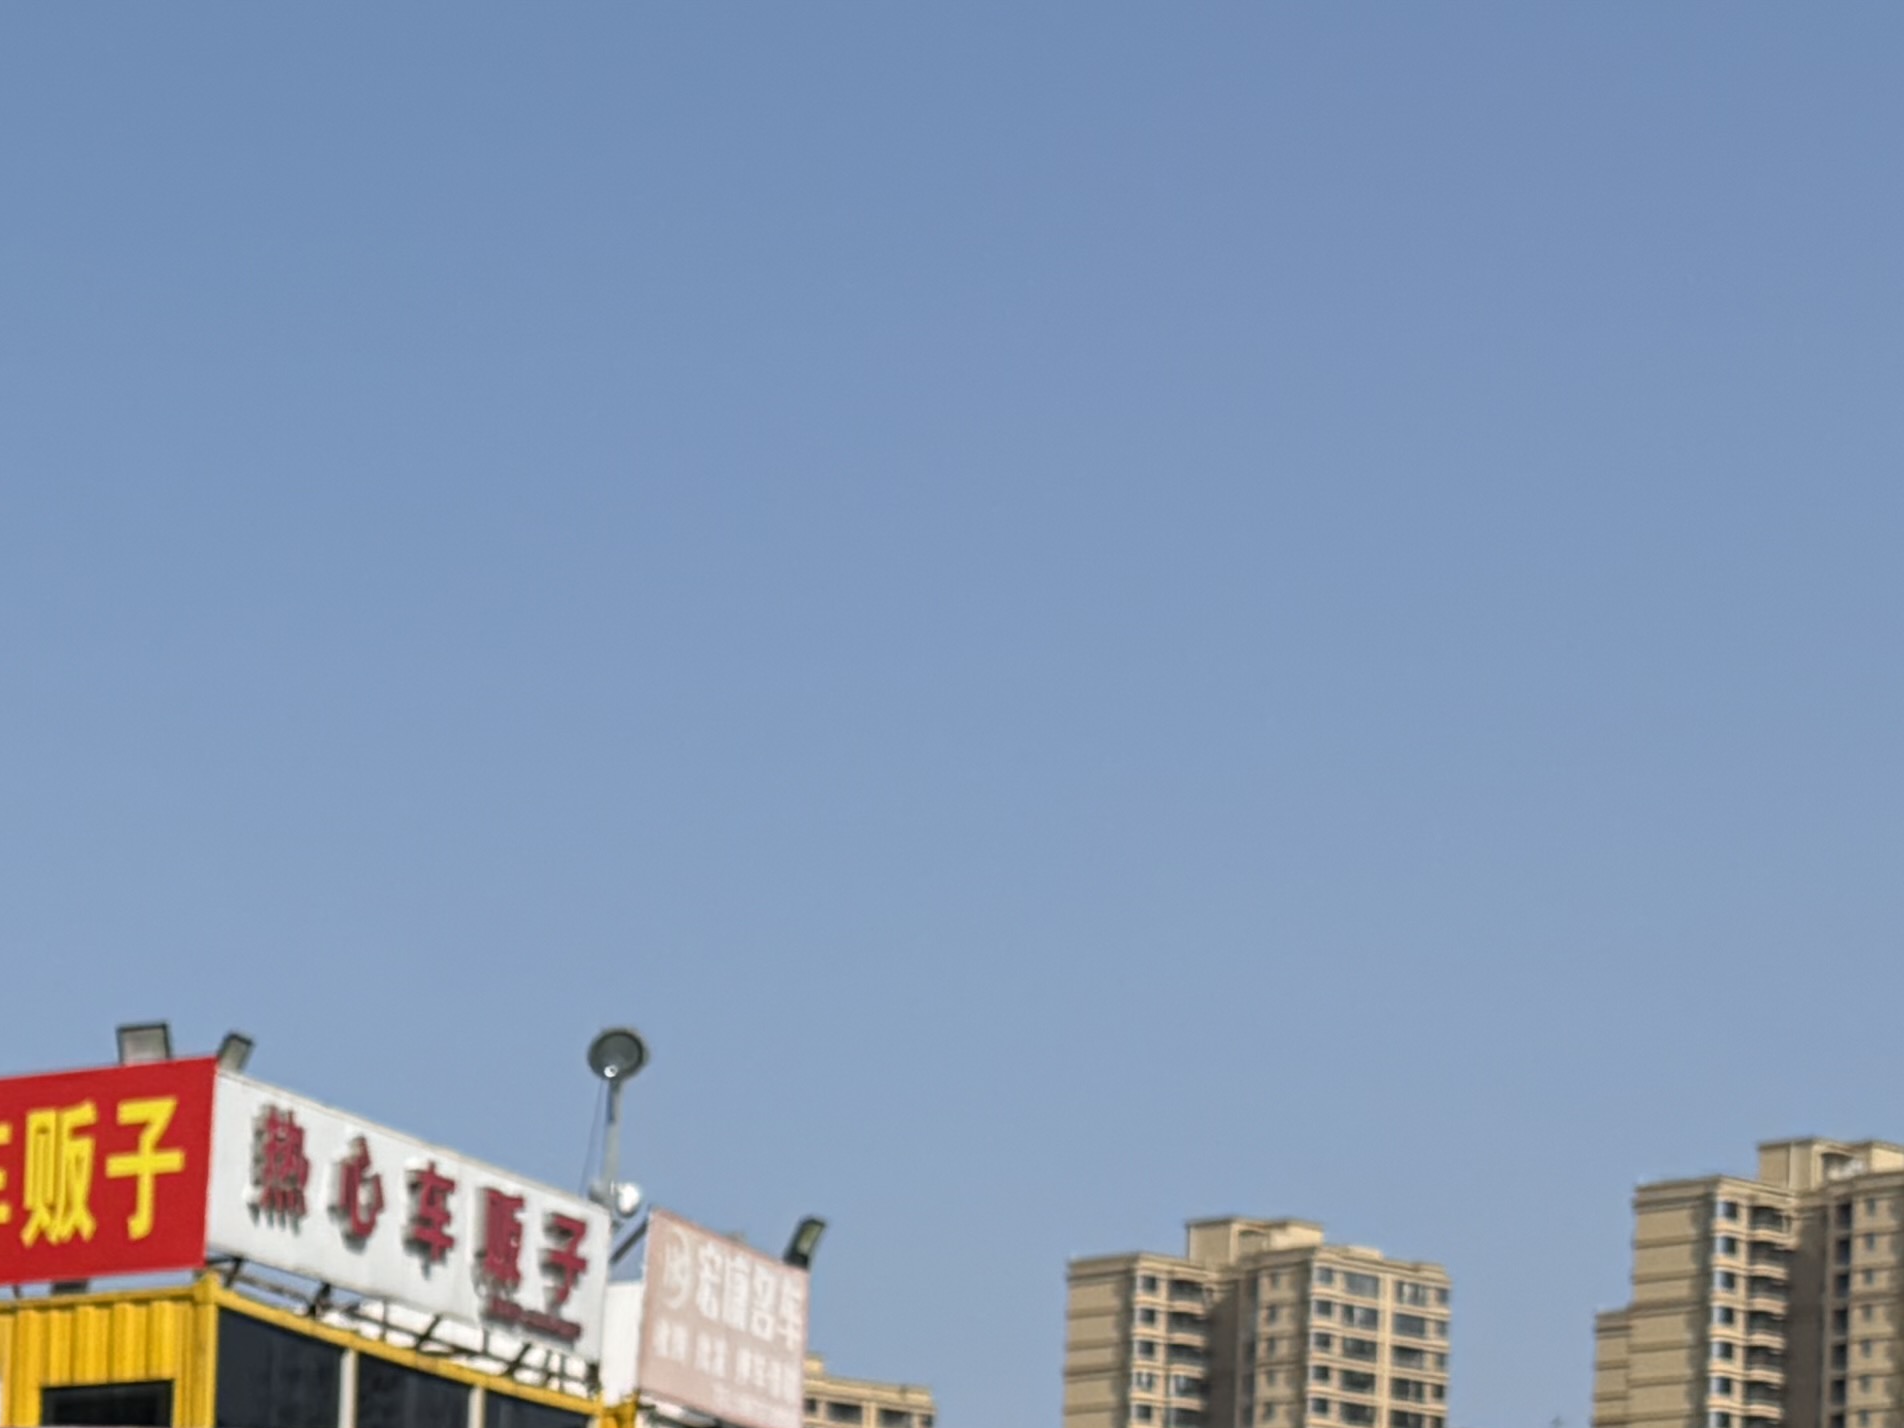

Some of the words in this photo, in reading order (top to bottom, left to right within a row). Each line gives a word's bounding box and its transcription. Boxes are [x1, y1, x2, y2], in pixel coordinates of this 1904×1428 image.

[252, 1103, 587, 1308] 热心车贩子
